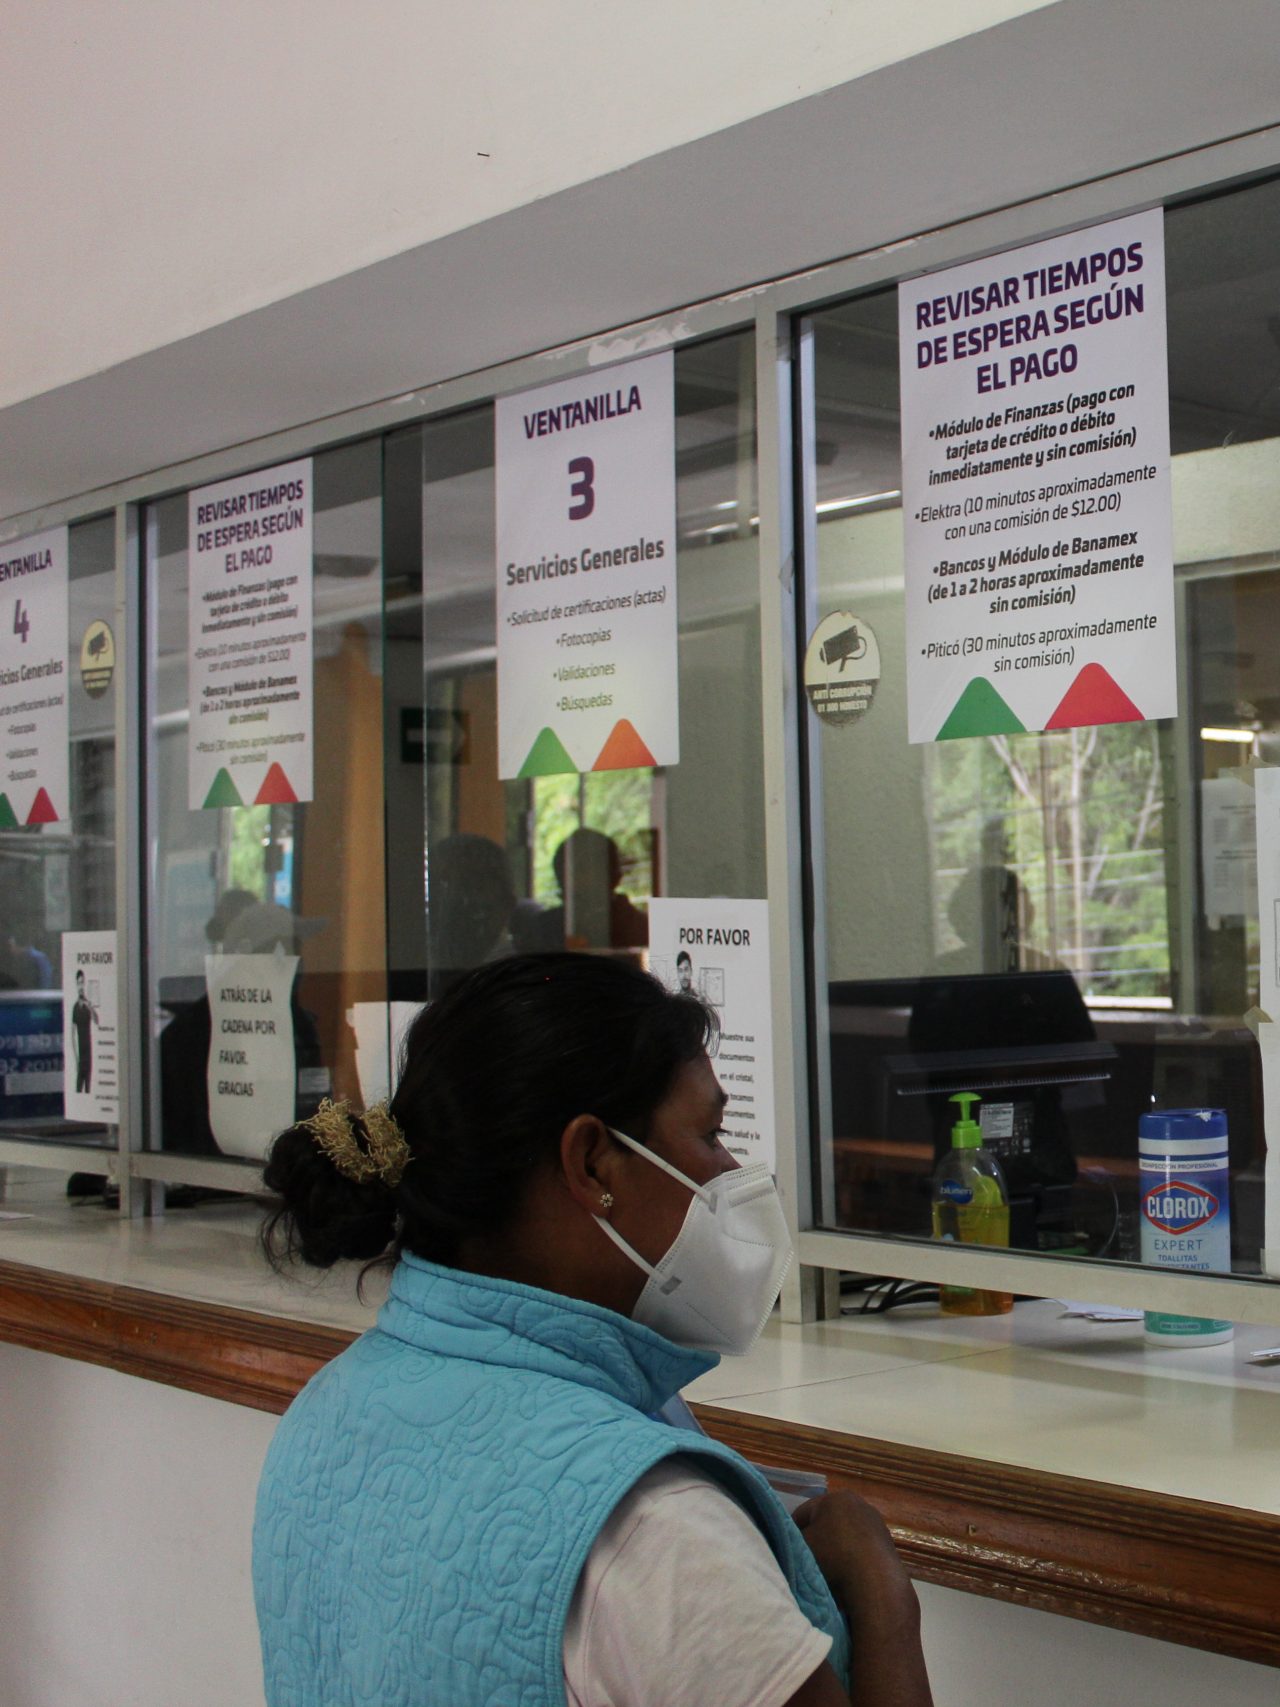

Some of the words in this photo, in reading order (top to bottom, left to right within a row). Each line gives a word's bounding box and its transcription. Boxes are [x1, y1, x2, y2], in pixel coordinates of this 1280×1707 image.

[916, 277, 1020, 330] REVISAR
[1023, 242, 1144, 300] TIEMPOS
[917, 336, 948, 369] DE
[953, 309, 1050, 360] ESPERA
[1053, 282, 1144, 334] SEGÚN
[977, 363, 1006, 394] EL
[1010, 343, 1078, 386] PAGO
[524, 384, 642, 439] VENTANILLA
[934, 415, 983, 441] Módulo
[986, 412, 1002, 430] de
[1004, 398, 1064, 425] Finanzas
[1067, 393, 1107, 415] (pago
[1109, 384, 1135, 402] con
[929, 451, 1033, 486] inmediatamente
[1035, 451, 1045, 467] y
[1046, 442, 1067, 461] sin
[1069, 426, 1137, 458] comisión)
[945, 434, 988, 460] tarjeta
[990, 432, 1007, 450] de
[1009, 421, 1057, 445] crédito
[1059, 422, 1068, 436] o
[1070, 411, 1116, 434] débito
[197, 494, 248, 526] REVISAR
[249, 480, 304, 513] TIEMPOS
[567, 456, 596, 521] 3
[920, 501, 962, 523] Elektra
[963, 496, 984, 518] (10
[985, 489, 1035, 510] minutos
[1038, 465, 1157, 503] aproximadamente
[197, 532, 213, 553] DE
[214, 519, 260, 548] ESPERA
[261, 504, 304, 536] SEGÚN
[944, 524, 967, 540] con
[969, 520, 992, 536] una
[994, 504, 1050, 531] comisión
[1052, 503, 1069, 520] de
[1071, 492, 1122, 518] $12.00)
[225, 553, 240, 574] EL
[241, 545, 273, 570] PAGO
[506, 551, 577, 586] Servicios
[581, 537, 665, 572] Generales
[938, 554, 985, 577] Bancos
[988, 556, 997, 572] y
[998, 542, 1050, 568] Módulo
[1052, 540, 1069, 557] de
[1071, 530, 1138, 555] Banamex
[927, 583, 949, 604] (de
[950, 580, 958, 597] 1
[959, 582, 967, 595] a
[969, 578, 978, 595] 2
[980, 574, 1016, 594] horas
[1019, 553, 1145, 588] aproximadamente
[989, 597, 1009, 613] sin
[1011, 585, 1076, 611] comisión)
[13, 599, 30, 643] 4
[511, 608, 549, 626] Solicitud
[551, 605, 563, 620] de
[564, 594, 632, 617] certificaciones
[633, 586, 667, 608] (actas)
[560, 627, 612, 647] Fotocopias
[926, 637, 960, 659] Piticó
[962, 636, 984, 657] (30
[986, 630, 1035, 651] minutos
[1038, 614, 1157, 644] aproximadamente
[21, 658, 63, 682] Generales
[558, 662, 615, 681] Validaciones
[993, 655, 1012, 672] sin
[1014, 647, 1075, 671] comisión)
[561, 693, 613, 712] Búsquedas
[679, 927, 704, 945] POR
[707, 928, 751, 947] FAVOR
[77, 952, 91, 966] POR
[92, 952, 114, 966] FAVOR
[220, 987, 249, 1003] ATRÁS
[249, 989, 260, 1003] DE
[260, 988, 273, 1003] LA
[221, 1019, 254, 1035] CADENA
[255, 1020, 277, 1036] POR
[218, 1050, 249, 1066] FAVOR.
[217, 1079, 254, 1097] GRACIAS
[1147, 1196, 1211, 1219] CLOROX
[1154, 1239, 1204, 1251] EXPERT
[1157, 1254, 1198, 1264] TOALLITAS
